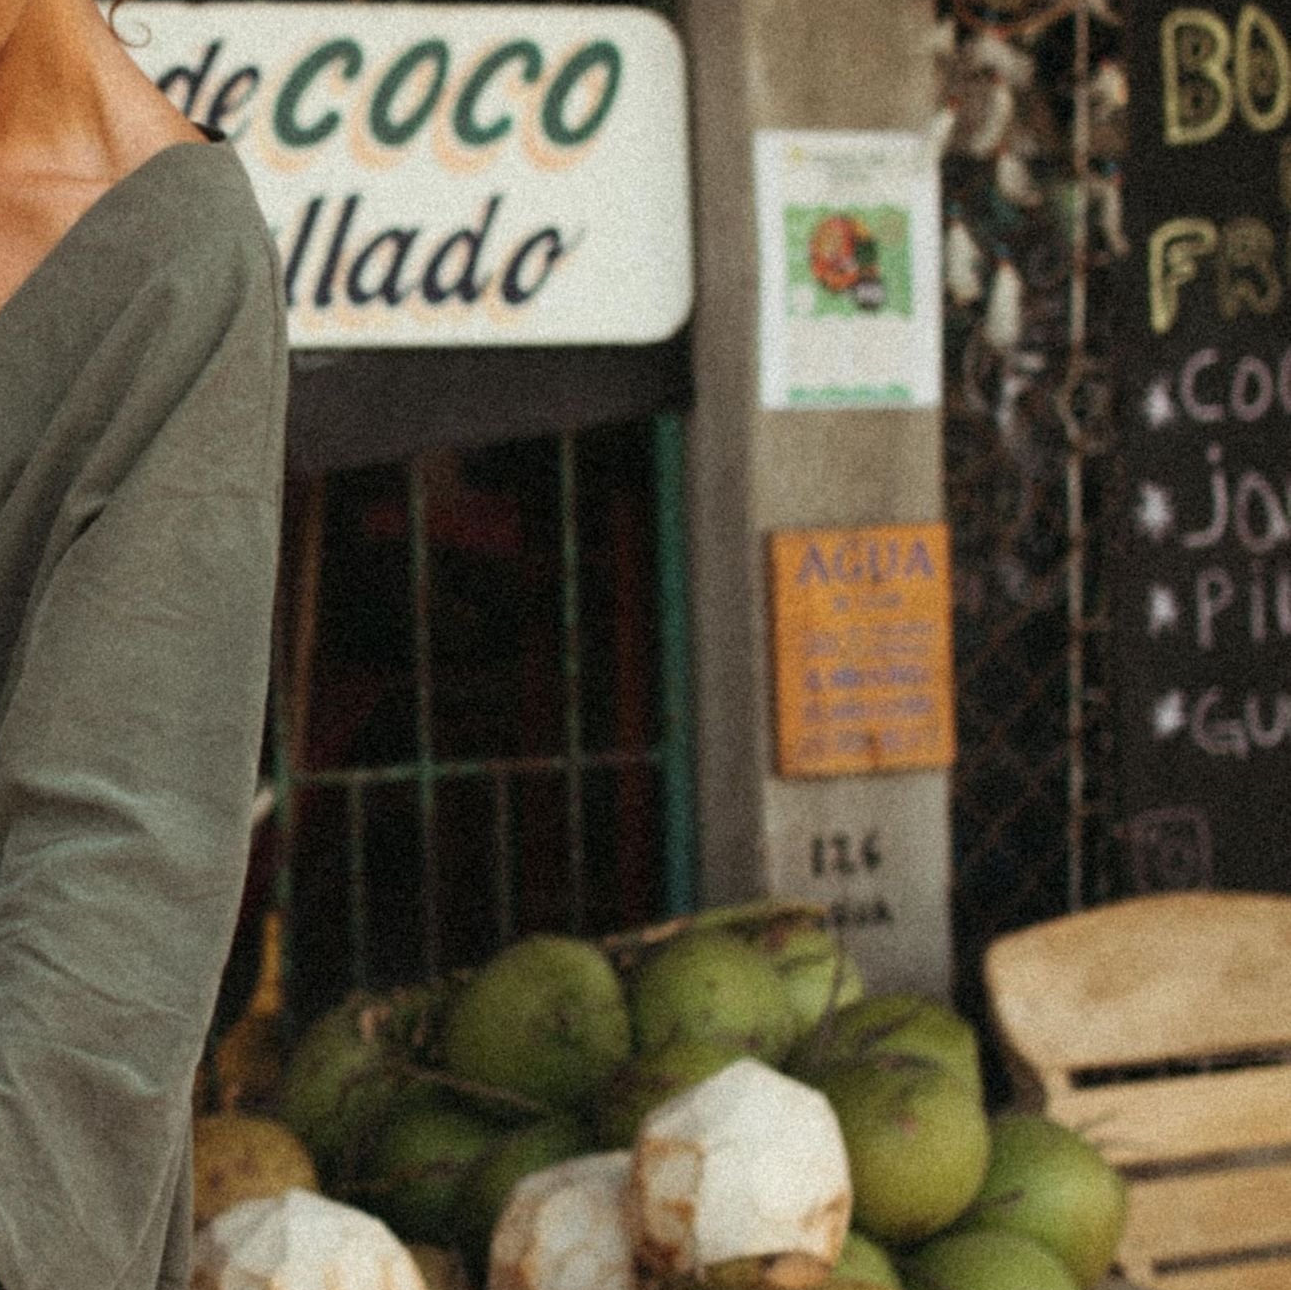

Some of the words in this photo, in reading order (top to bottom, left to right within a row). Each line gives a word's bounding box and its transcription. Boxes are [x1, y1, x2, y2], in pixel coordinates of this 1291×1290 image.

[158, 39, 260, 134] de
[274, 37, 622, 148] COCO
[270, 194, 567, 307] llado
[1147, 218, 1291, 336] FR
[1190, 683, 1291, 760] GU
